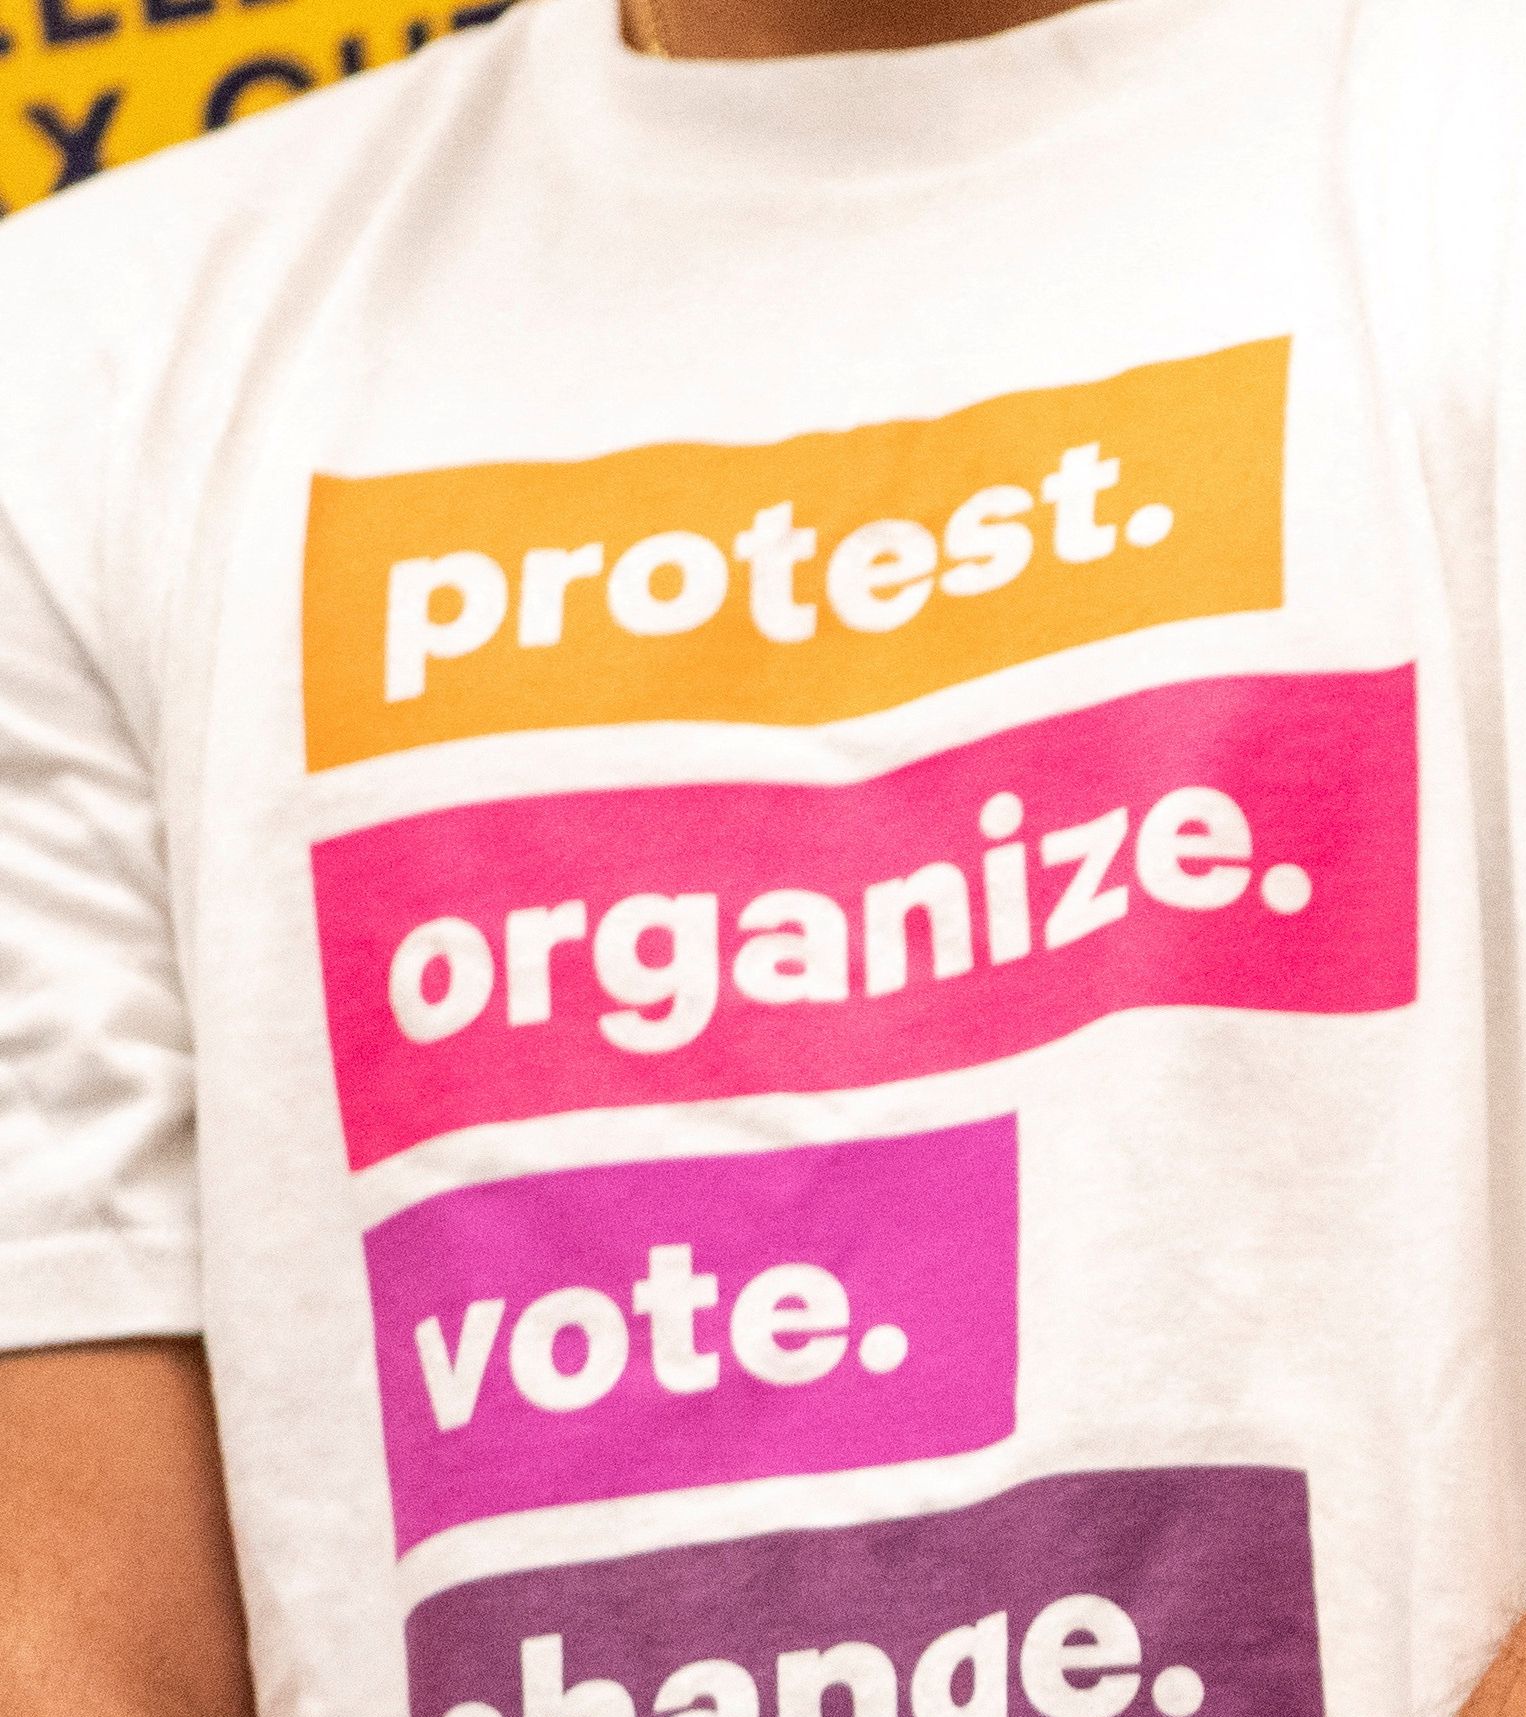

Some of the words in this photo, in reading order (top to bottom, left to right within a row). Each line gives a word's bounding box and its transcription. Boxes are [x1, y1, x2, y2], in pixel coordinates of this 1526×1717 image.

[385, 442, 1175, 704] protest.
[388, 787, 1311, 1054] organize.
[414, 1244, 908, 1431] vote.
